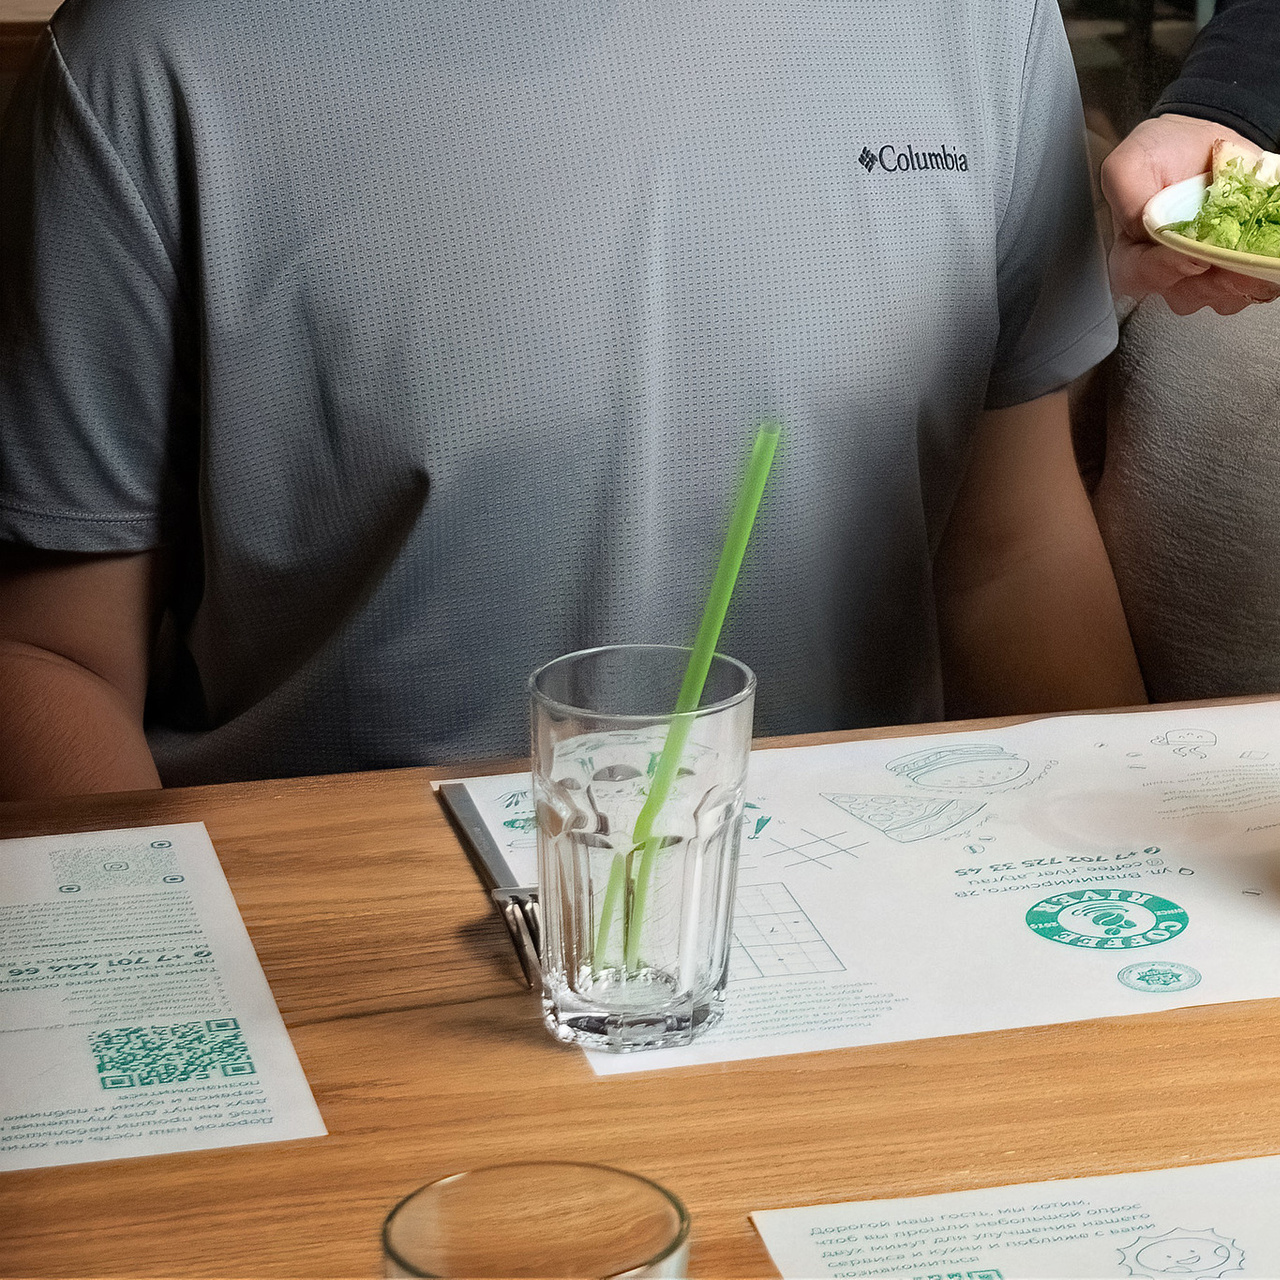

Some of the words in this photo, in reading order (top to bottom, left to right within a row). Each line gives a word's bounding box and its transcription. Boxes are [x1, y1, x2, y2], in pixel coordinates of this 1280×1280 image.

[878, 144, 969, 172] Columbia
[1032, 890, 1154, 913] RIVER
[1051, 921, 1183, 948] COFFEE
[117, 1080, 260, 1101] познакомиться
[162, 1103, 220, 1115] минут
[229, 1109, 271, 1119] чтоб
[1, 1125, 111, 1143] небольшой
[116, 1116, 193, 1130] прошли
[148, 1127, 188, 1136] наш
[194, 1117, 274, 1132] Дорогой
[810, 1219, 891, 1236] Дорогой
[896, 1216, 935, 1226] наш
[998, 1206, 1026, 1215] мы
[1031, 1199, 1092, 1212] хотим,
[815, 1235, 859, 1246] чтоб
[894, 1223, 970, 1237] прошли
[975, 1210, 1082, 1228] небольшой
[1086, 1203, 1143, 1215] опрос
[870, 1239, 926, 1252] минут
[933, 1235, 968, 1245] для
[972, 1223, 1077, 1241] улучшения
[1082, 1213, 1151, 1228] нашего
[1005, 1232, 1089, 1248] поближе
[1110, 1223, 1156, 1236] вами
[833, 1255, 980, 1279] познакомиться
